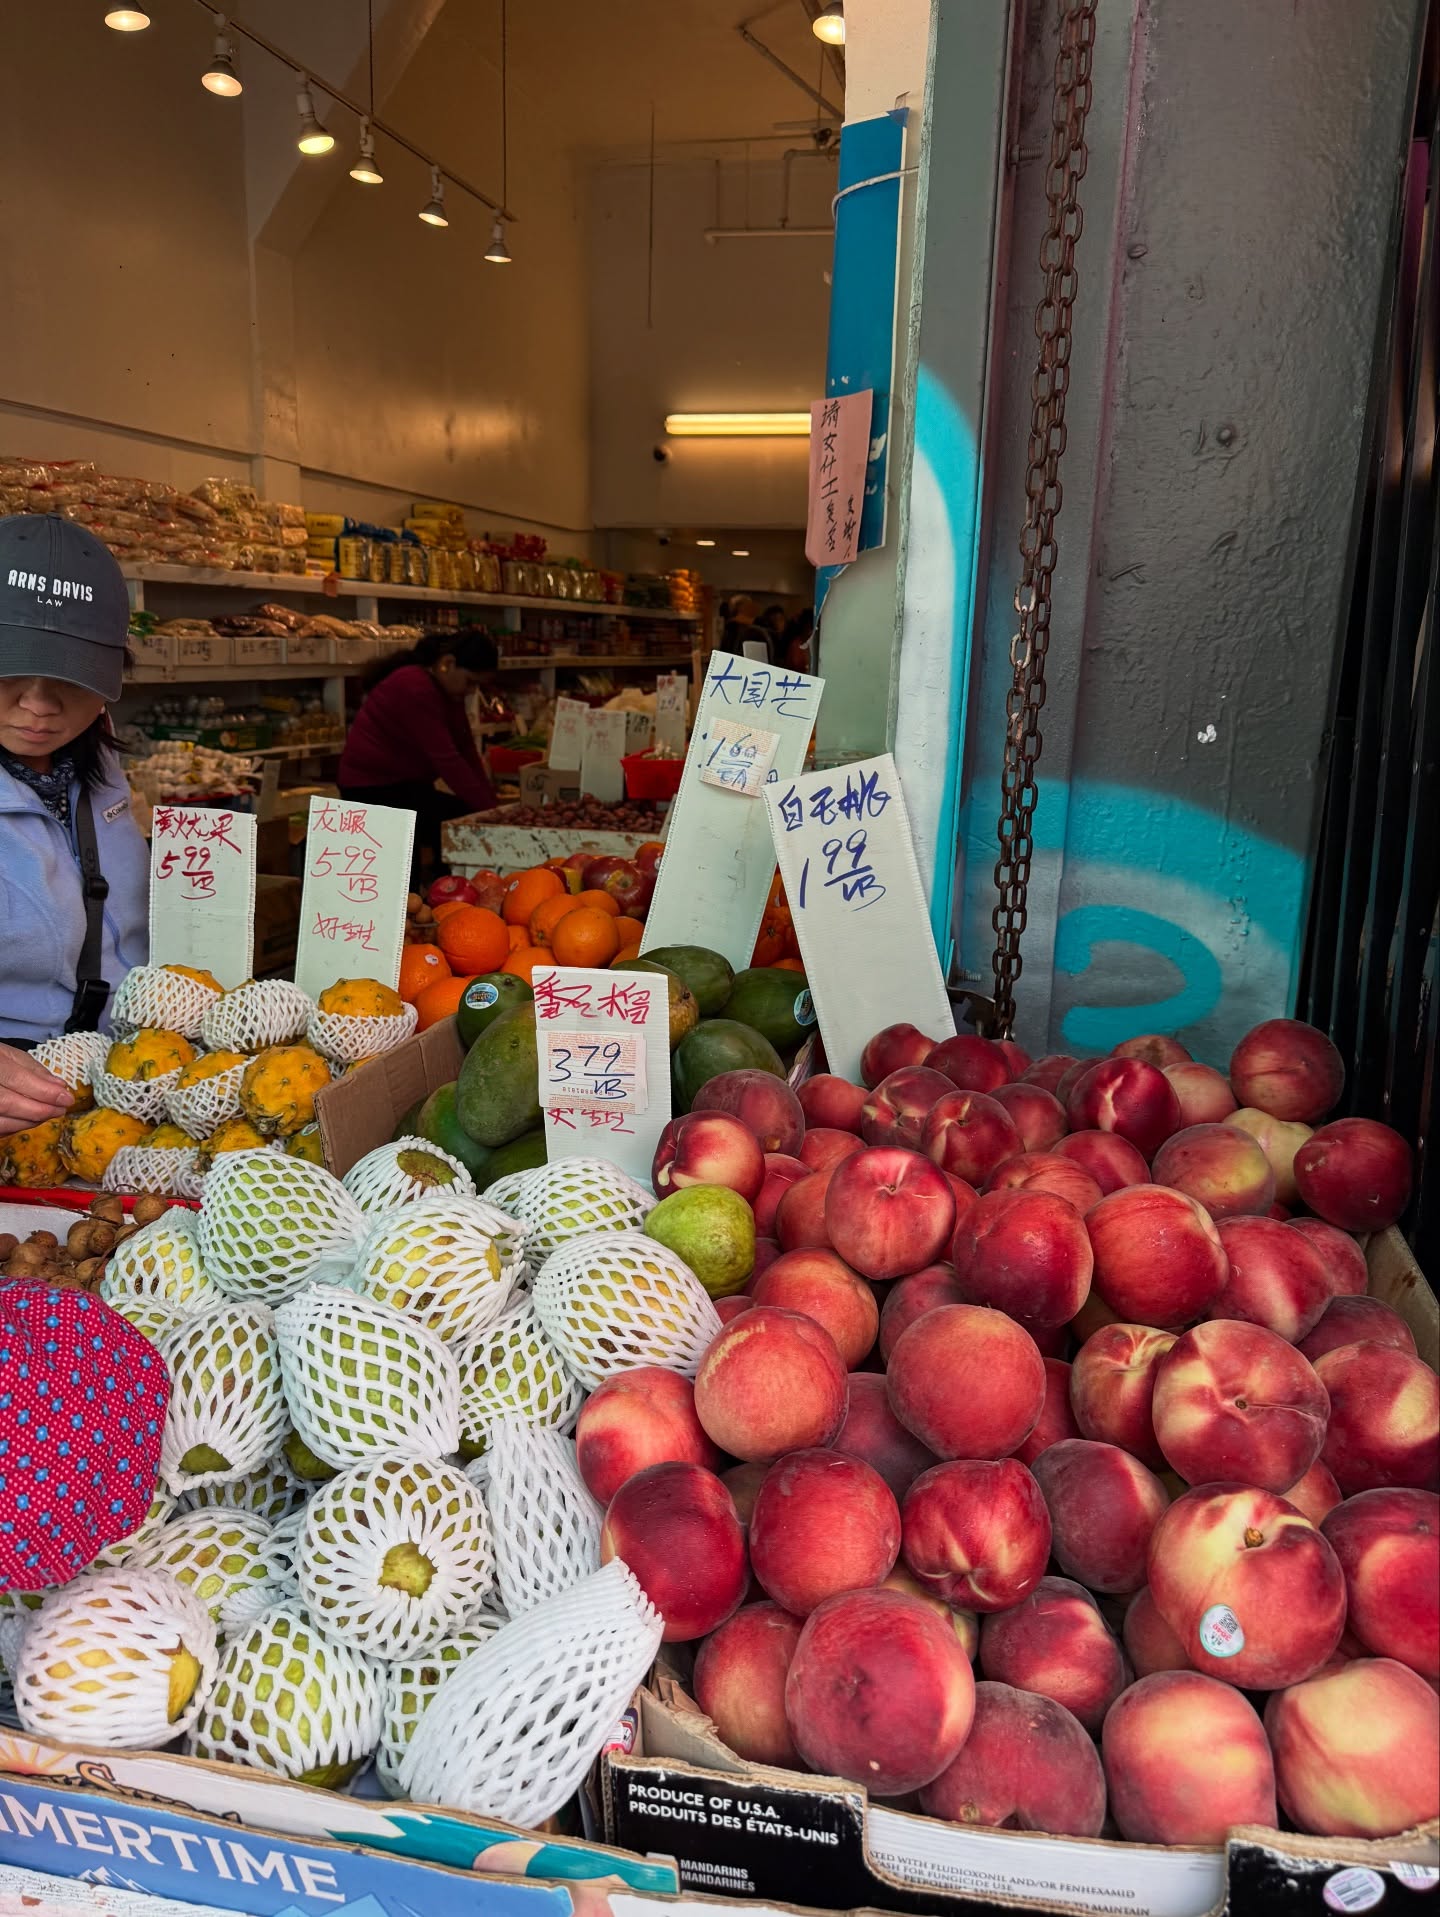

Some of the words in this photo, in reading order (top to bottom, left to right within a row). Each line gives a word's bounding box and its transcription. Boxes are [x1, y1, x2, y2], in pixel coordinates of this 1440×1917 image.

[7, 569, 47, 592] ARNS
[52, 578, 93, 602] DAVIS
[37, 595, 62, 607] LAW
[628, 1783, 704, 1807] PRODUCE
[709, 1795, 732, 1811] OF
[737, 1800, 781, 1819] U.S.A.
[629, 1800, 707, 1824] PRODUITS
[711, 1813, 742, 1830] DES
[746, 1816, 839, 1845] ÉTATS-UNIS
[0, 1793, 346, 1903] MERTIME
[680, 1858, 749, 1879] MANDARINS
[681, 1870, 756, 1892] MANDARINES
[877, 1860, 900, 1871] ASH
[904, 1865, 925, 1877] FOR
[928, 1870, 989, 1888] FUNGICIDE
[897, 1855, 928, 1869] WITH
[931, 1863, 1005, 1882] FLUDIOXONIL
[1009, 1876, 1056, 1890] AND/OR
[1059, 1883, 1135, 1898] FENHEXAMID
